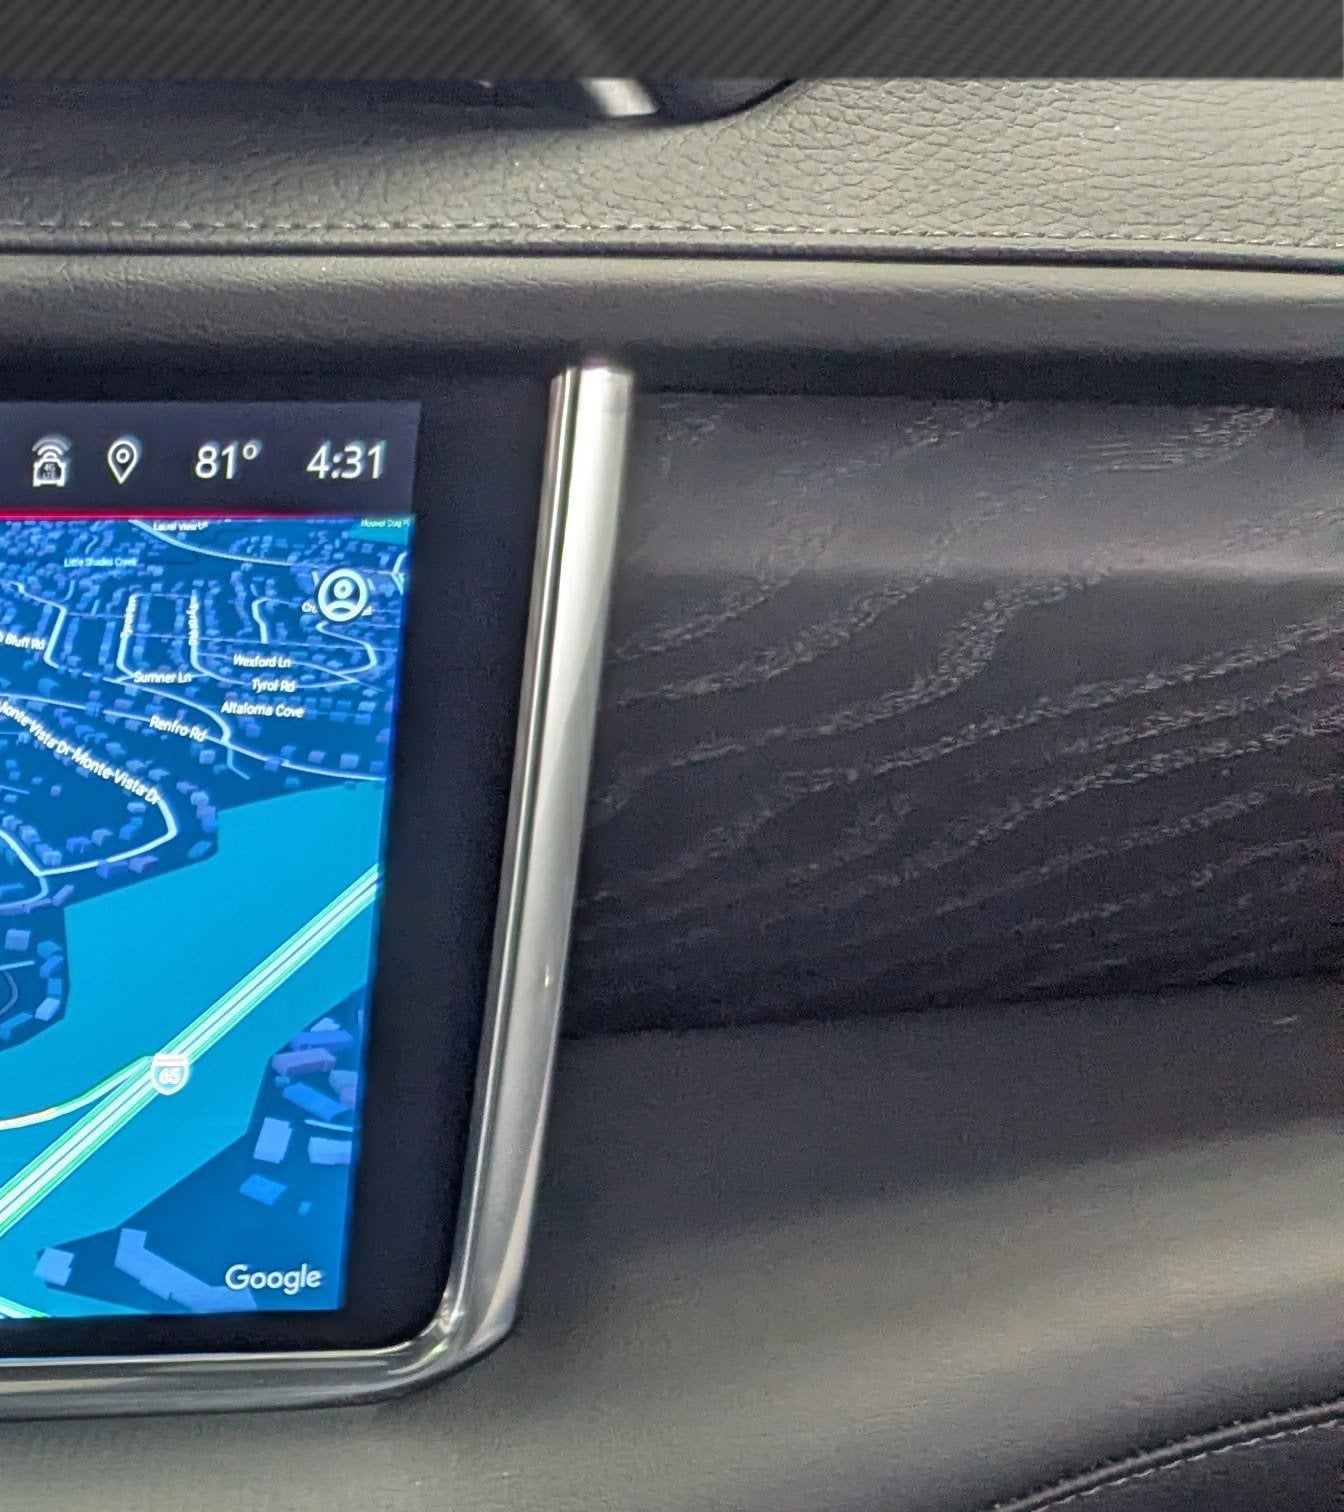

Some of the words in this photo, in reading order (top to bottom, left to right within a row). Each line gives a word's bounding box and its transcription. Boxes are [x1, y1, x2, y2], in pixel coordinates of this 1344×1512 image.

[195, 440, 263, 480] 81°
[306, 440, 388, 480] 4:31
[279, 679, 296, 693] Rd
[220, 701, 273, 716] Altaloma
[275, 704, 305, 719] Cove
[29, 718, 57, 747] Vista
[55, 739, 72, 755] Dr
[149, 715, 189, 737] Renfro
[188, 726, 207, 743] Rd
[71, 747, 114, 781] Monte
[112, 769, 146, 797] Vista
[144, 787, 161, 805] Dr
[159, 1067, 182, 1085] 65
[224, 1264, 323, 1296] Google
